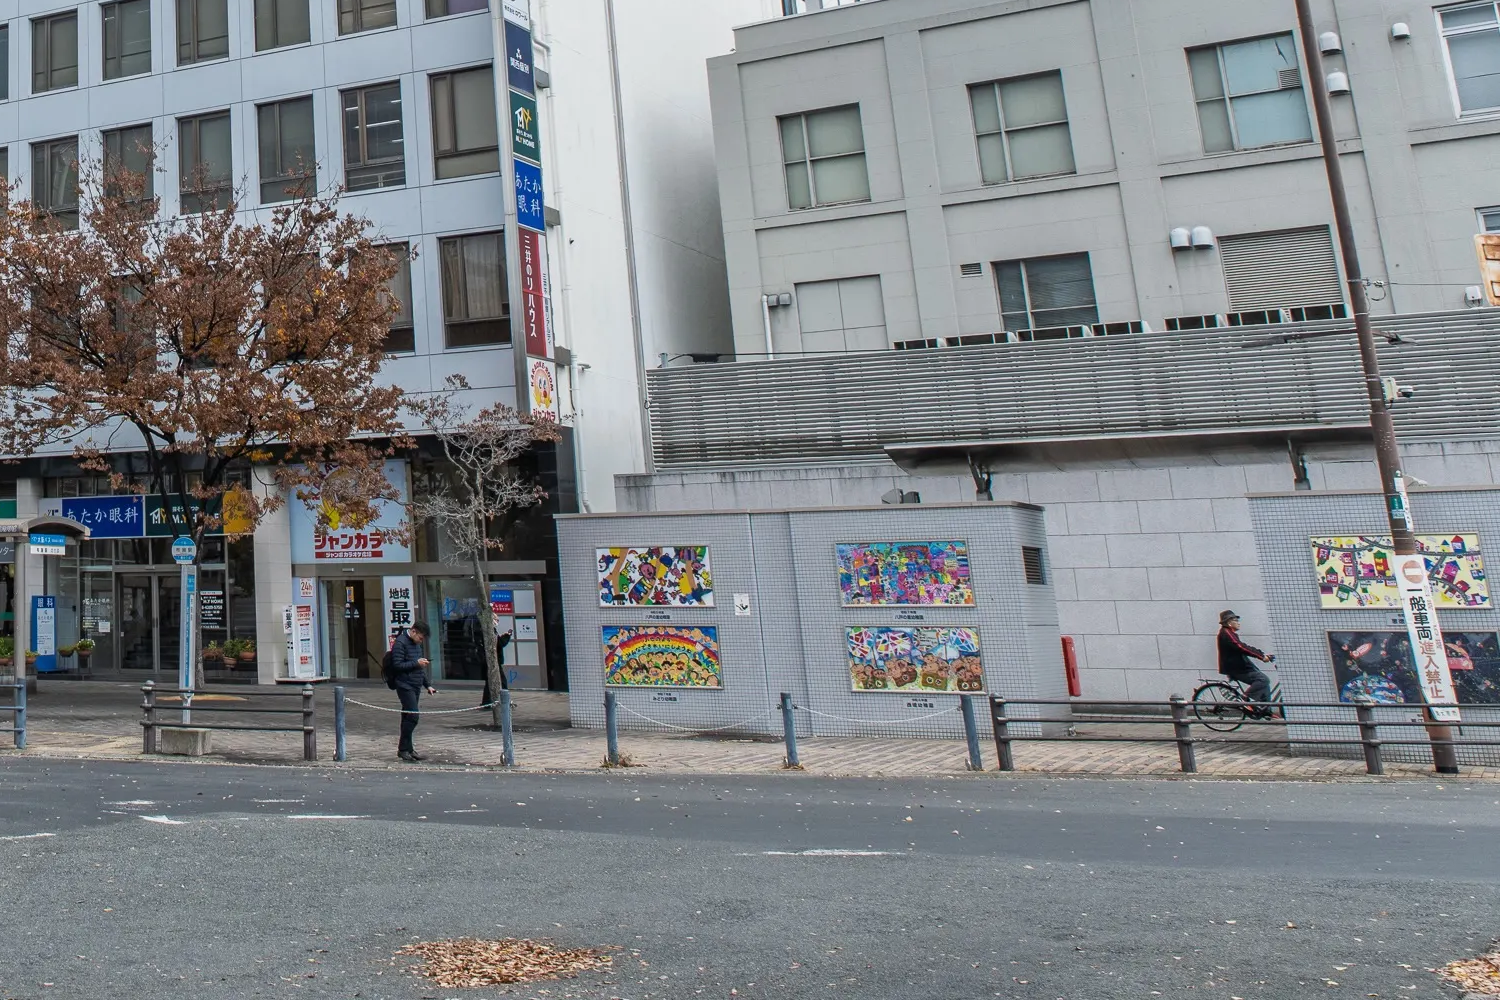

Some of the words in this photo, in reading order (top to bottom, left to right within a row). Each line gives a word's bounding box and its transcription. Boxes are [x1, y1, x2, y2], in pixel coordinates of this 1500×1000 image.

[515, 172, 541, 194] あたか
[517, 194, 541, 218] 眼科
[524, 235, 537, 338] 三井のリハウス
[66, 506, 139, 525] あたか眼科
[314, 532, 382, 550] ジャンカラ
[300, 582, 312, 591] 24h
[389, 587, 410, 599] 地域
[37, 597, 54, 608] 眼科
[1406, 588, 1445, 699] 一般車両進入禁止
